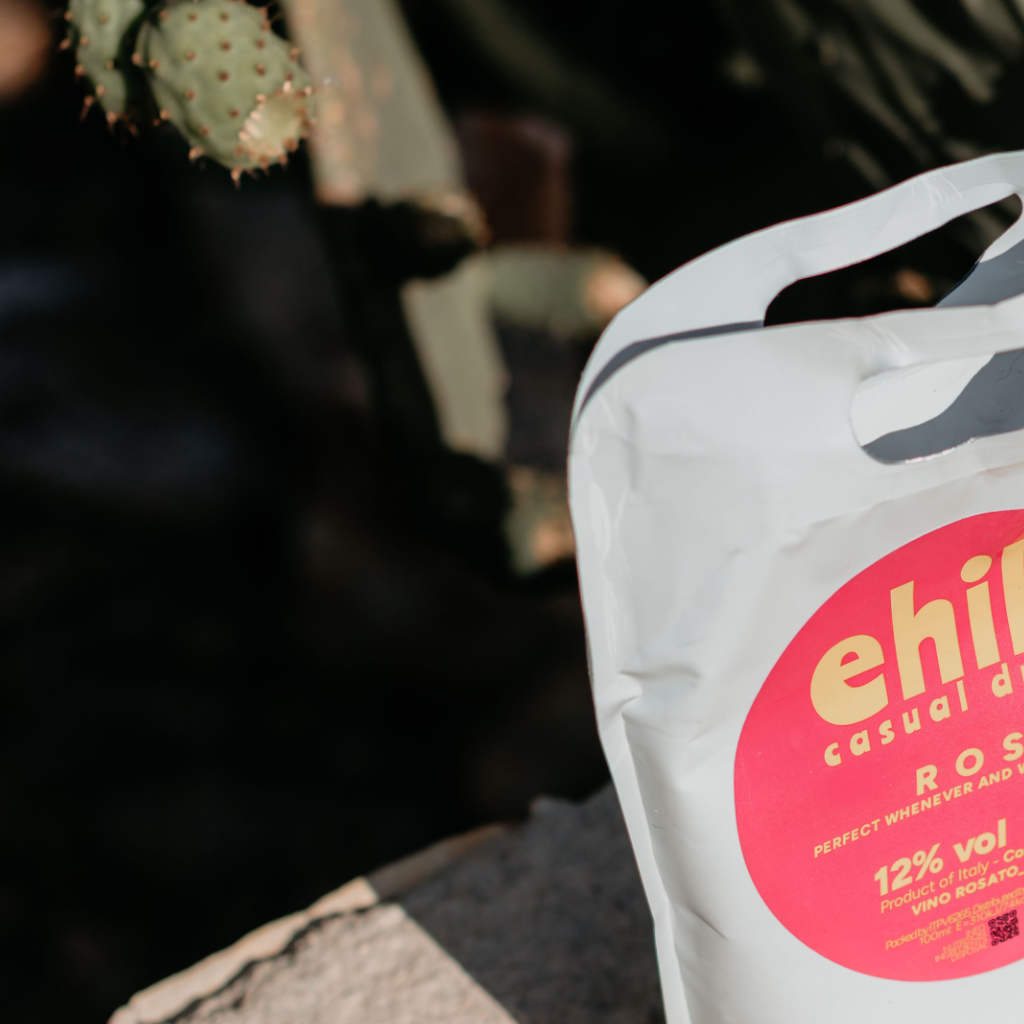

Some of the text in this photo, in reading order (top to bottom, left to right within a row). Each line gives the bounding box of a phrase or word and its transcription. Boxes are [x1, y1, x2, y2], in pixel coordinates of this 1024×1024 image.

[824, 680, 968, 767] casual
[813, 819, 880, 859] PERFECT
[884, 782, 973, 826] WHENEVER
[978, 767, 1013, 790] AND
[874, 843, 944, 897] 12%
[953, 818, 1007, 862] vol
[880, 881, 935, 914] Product
[939, 871, 955, 889] of
[958, 860, 990, 882] Italy
[911, 892, 952, 916] VINO
